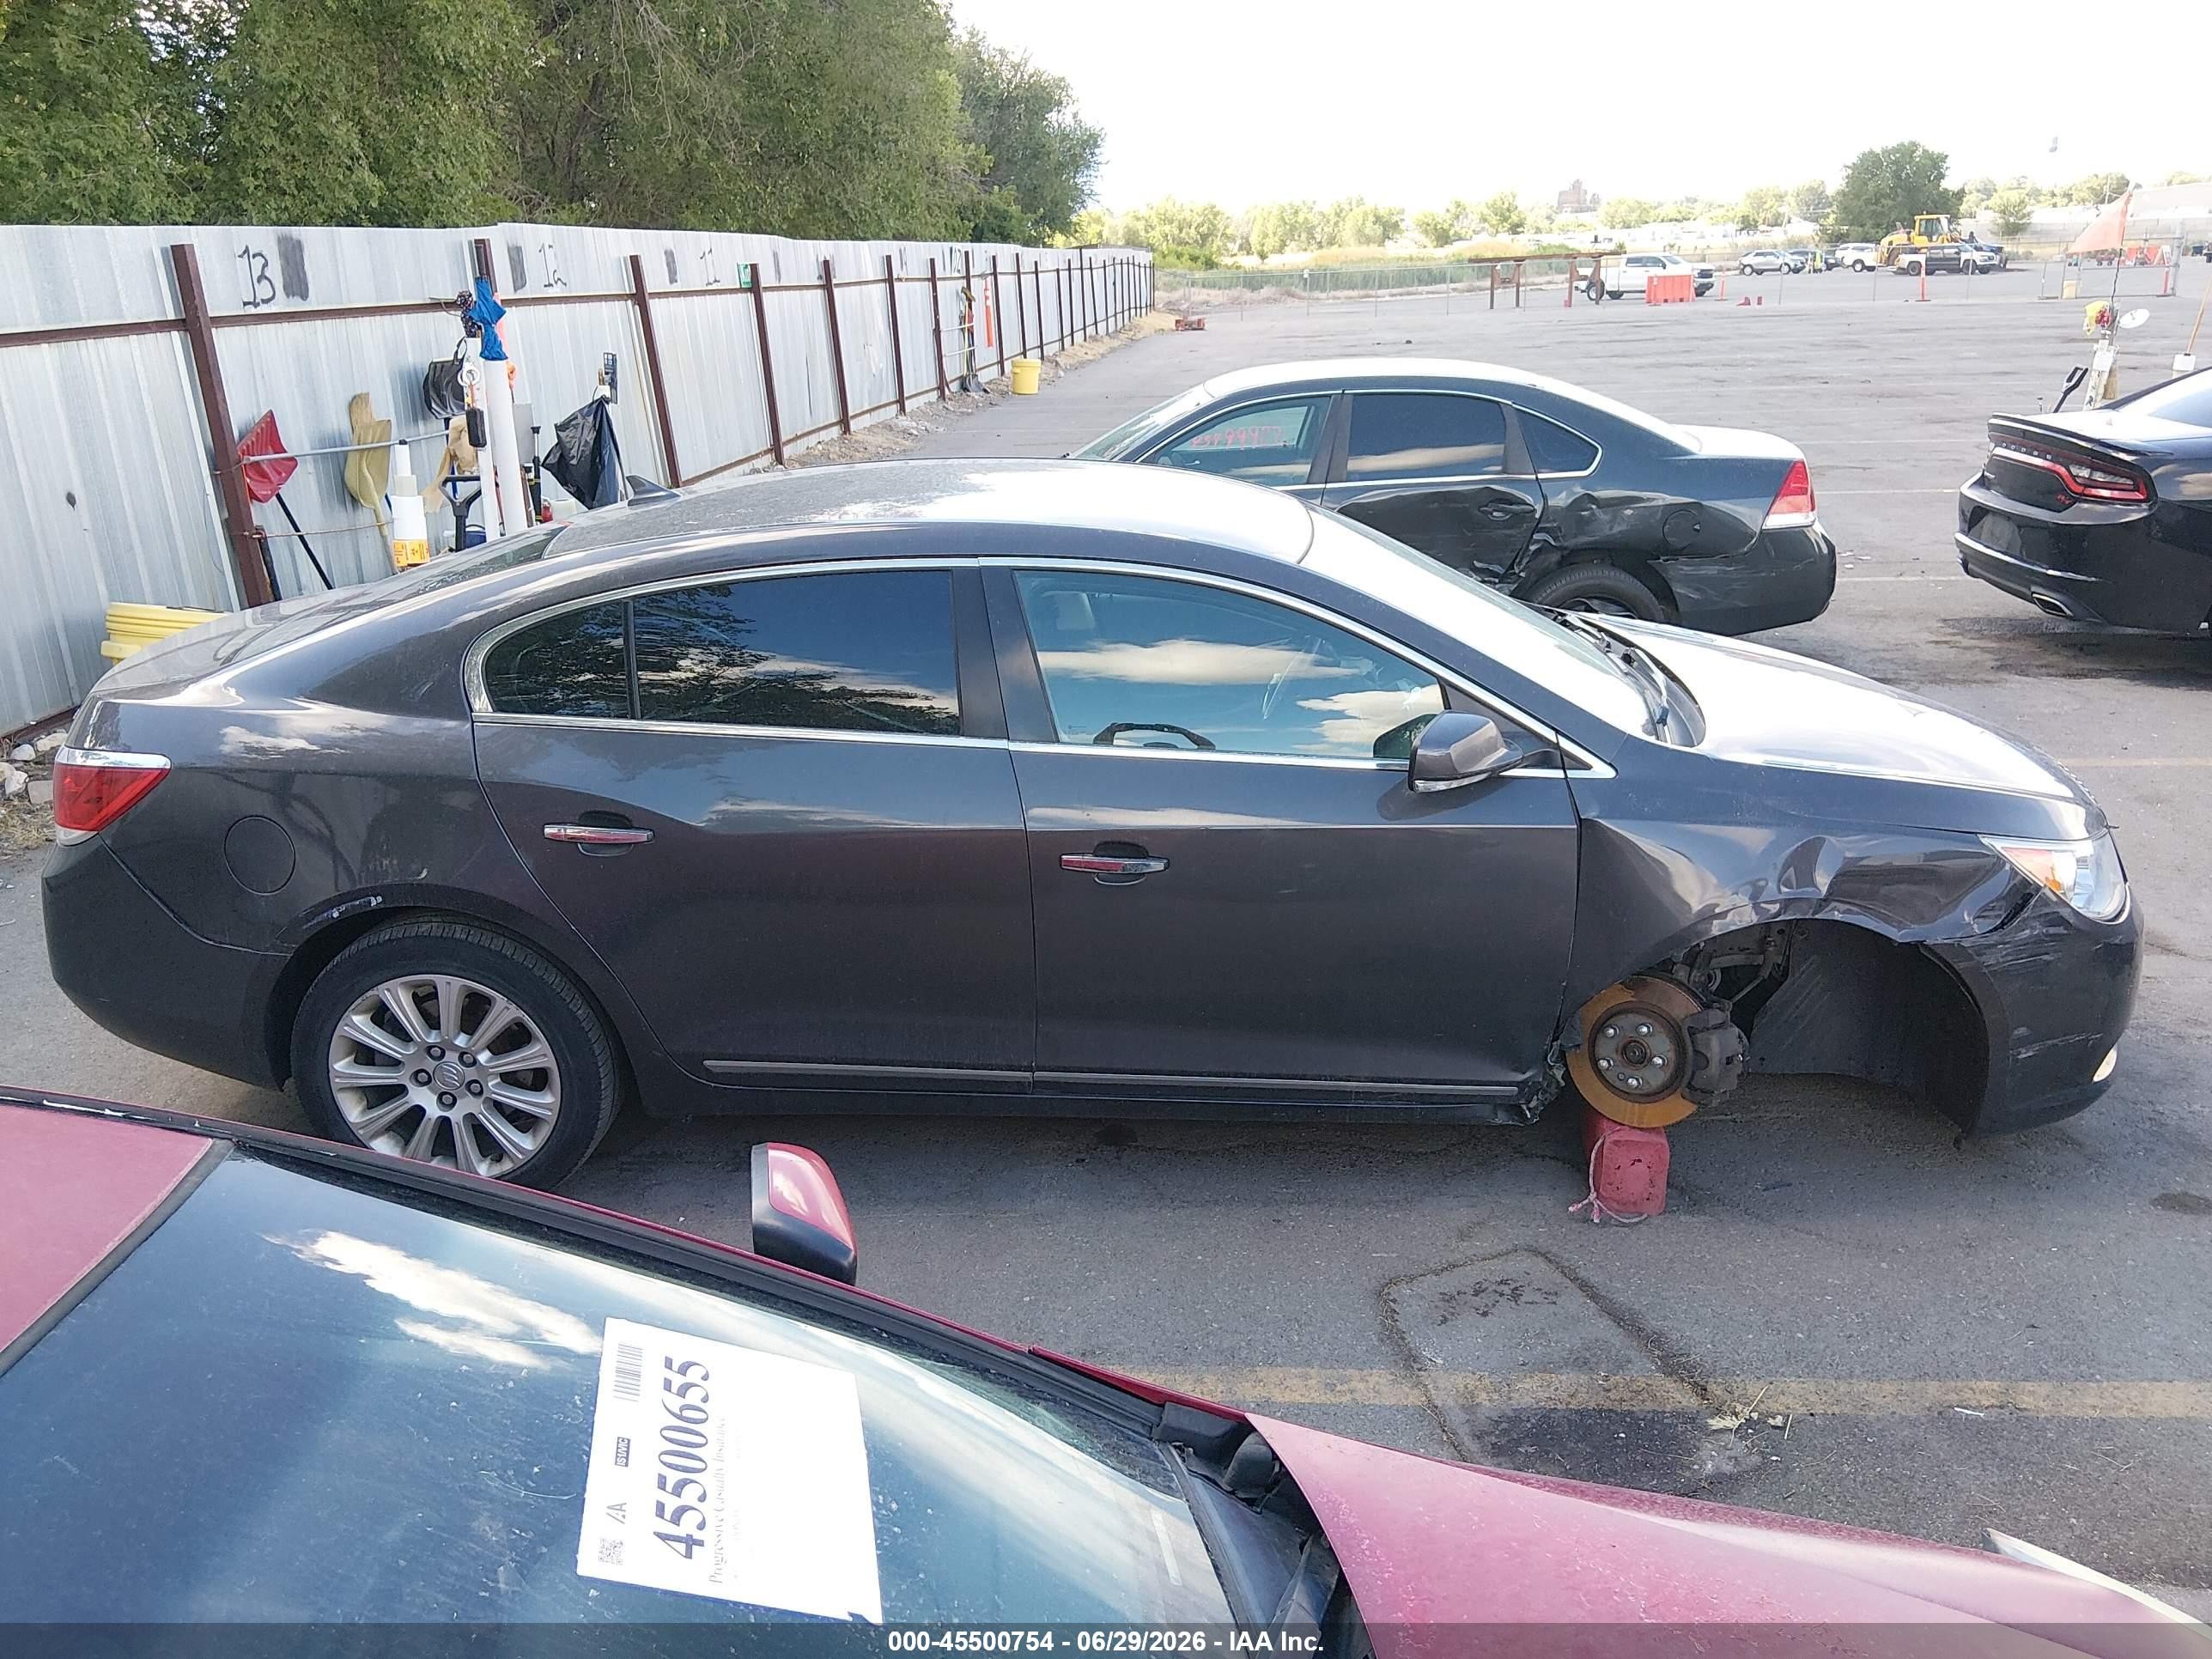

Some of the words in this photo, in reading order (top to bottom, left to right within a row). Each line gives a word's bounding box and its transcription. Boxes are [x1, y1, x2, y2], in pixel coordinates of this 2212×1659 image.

[237, 244, 276, 308] 13
[653, 1355, 709, 1559] 45500655
[708, 1515, 726, 1584] Progressive
